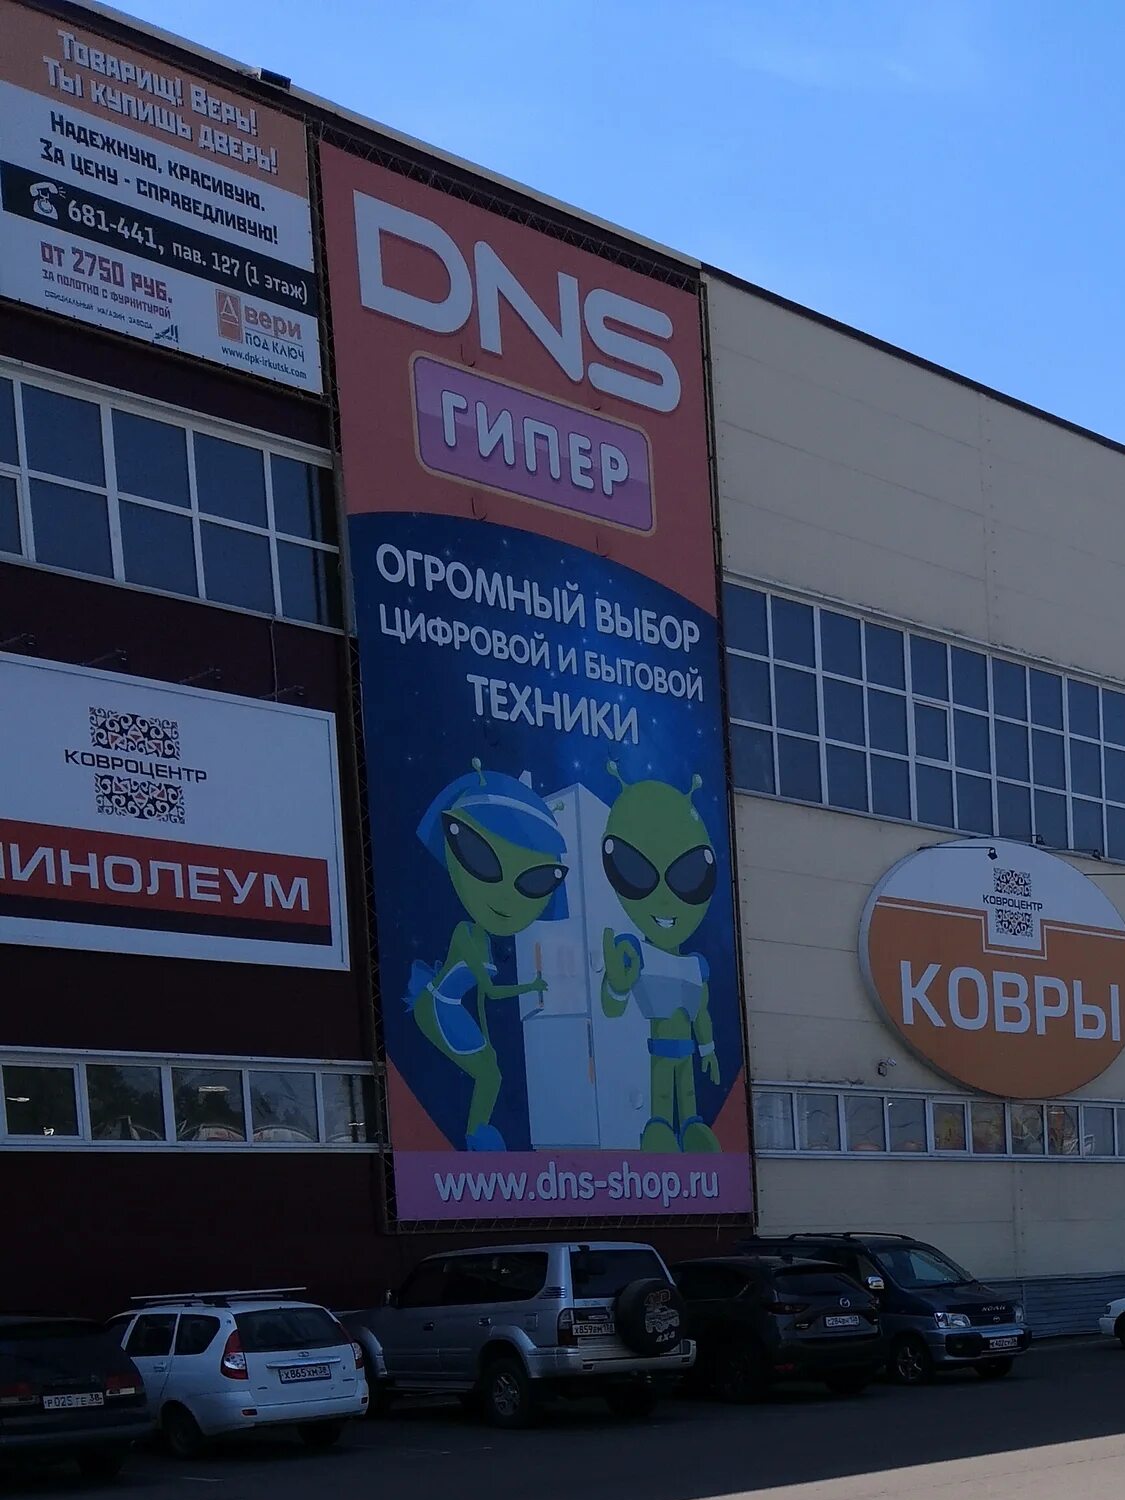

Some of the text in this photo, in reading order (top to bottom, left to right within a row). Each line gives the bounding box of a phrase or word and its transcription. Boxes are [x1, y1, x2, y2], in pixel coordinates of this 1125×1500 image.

[90, 80, 193, 141] КУПИШЬ
[198, 124, 279, 175] ДВЕРЬ!
[71, 153, 119, 186] ЦЕНУ
[136, 177, 279, 245] СПРАВЕДЛИВУЮ!
[41, 241, 173, 304] ОТ 2750 РУБ.
[57, 275, 99, 298] ПОЛОТНО
[102, 289, 108, 299] С
[110, 291, 172, 320] ФУРНИТУРОЙ
[172, 242, 207, 267] пав.
[211, 252, 240, 278] 127
[245, 260, 260, 288] (1
[264, 272, 308, 305] этаж)
[353, 189, 681, 413] DNS
[245, 332, 305, 363] ПОД КЛЮЧ
[440, 389, 630, 496] ГИПЕР
[375, 542, 701, 653] ОГРОМНЫЙ ВЫБОР
[379, 603, 704, 702] ЦИФРОВОЙ И БЫТОВОЙ
[466, 673, 639, 746] ТЕХНИКИ
[64, 749, 207, 784] КОВРОЦЕНТР
[0, 840, 310, 912] ИНОЛЕУМ
[982, 893, 1043, 912] КОВРОЦЕНТР
[900, 959, 1121, 1042] КОВРЫ
[434, 1160, 720, 1207] www.dns-shop.ru
